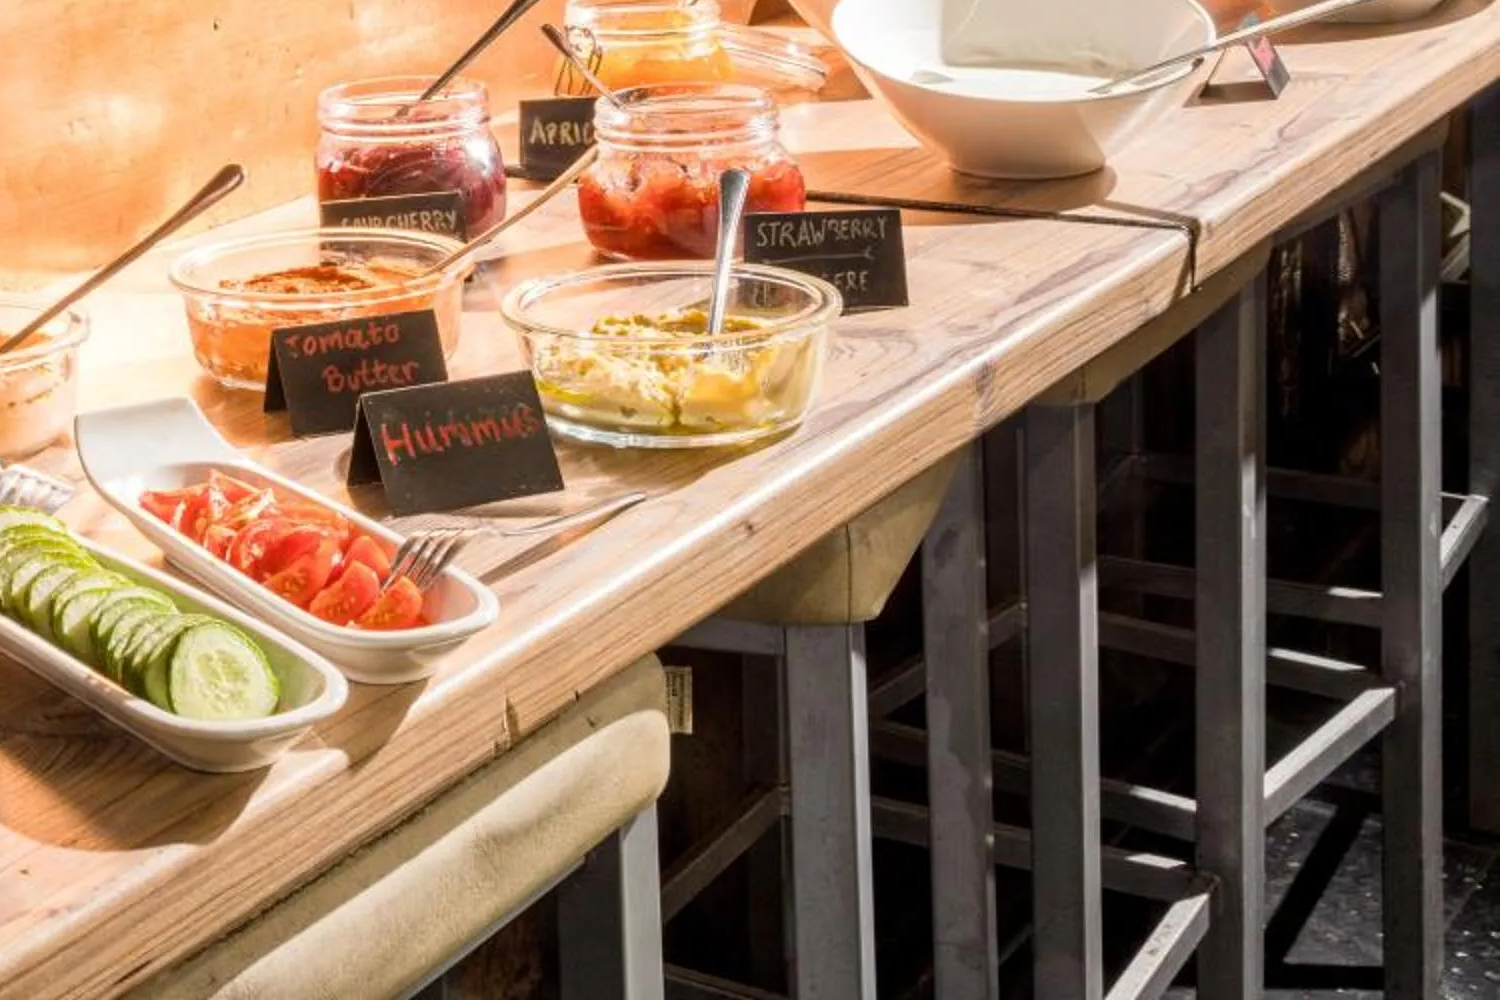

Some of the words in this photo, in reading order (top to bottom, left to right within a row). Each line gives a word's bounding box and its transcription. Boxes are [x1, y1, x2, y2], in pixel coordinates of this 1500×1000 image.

[756, 215, 887, 248] STRAWBERRY
[285, 321, 400, 358] Tomato
[323, 358, 419, 392] Butter
[380, 406, 541, 467] Hummus
